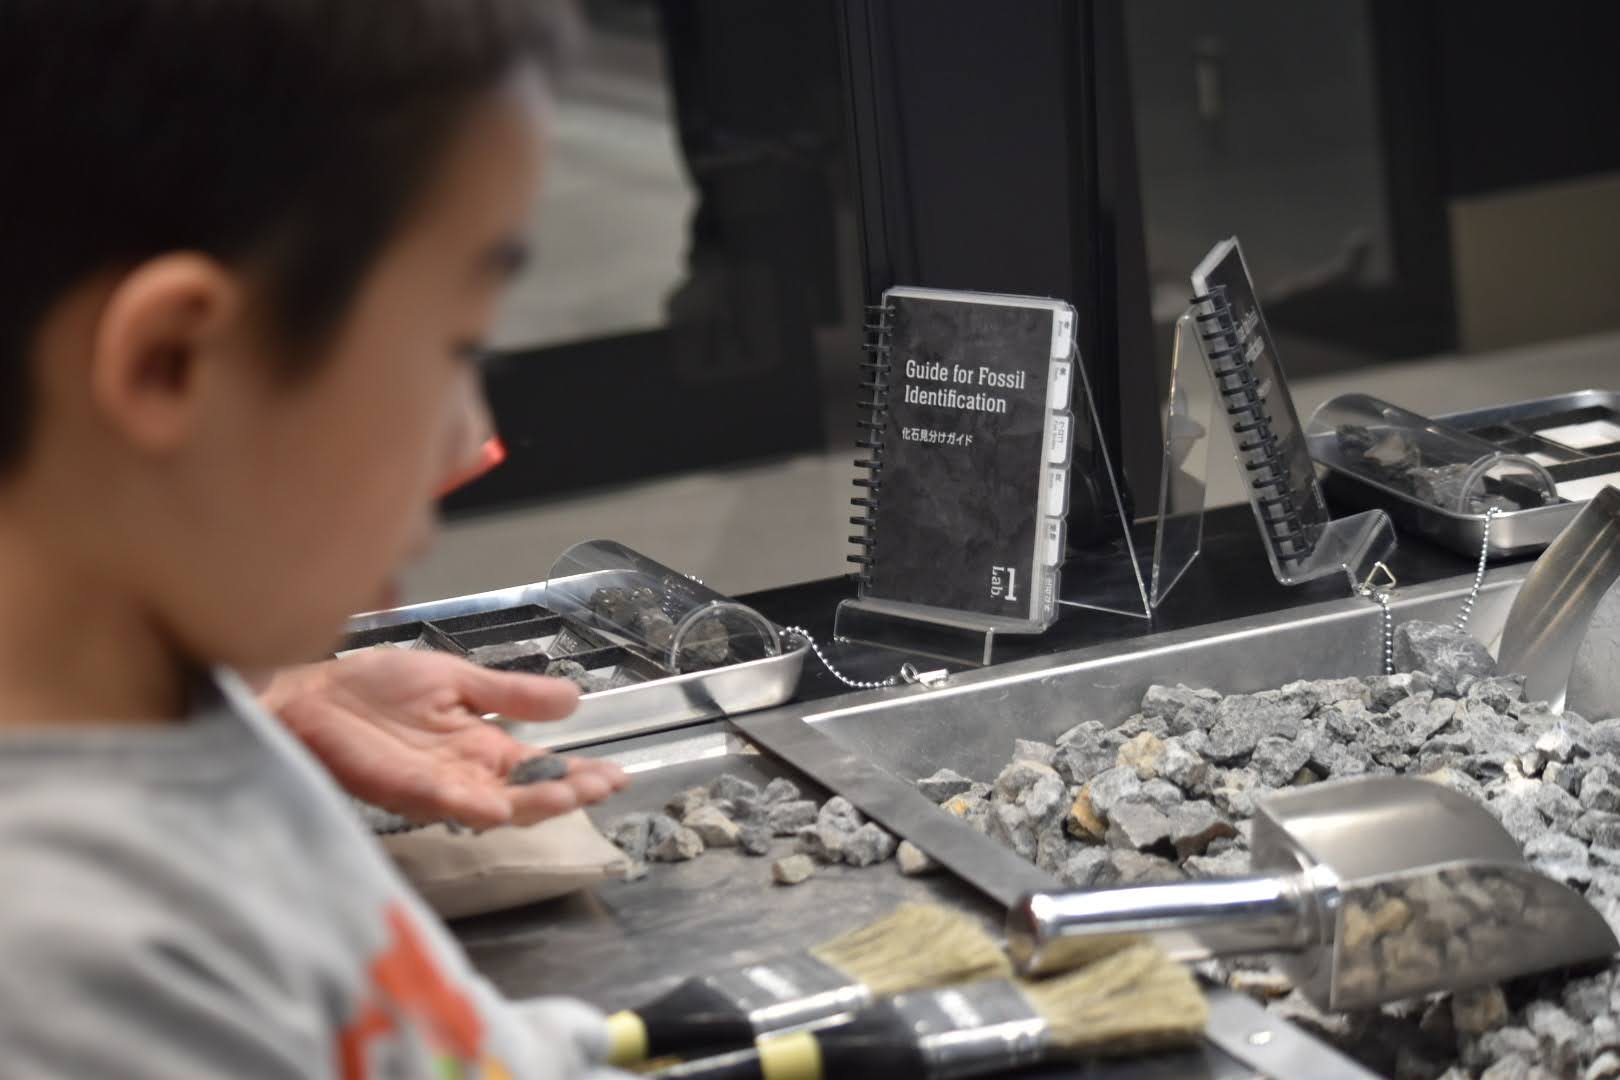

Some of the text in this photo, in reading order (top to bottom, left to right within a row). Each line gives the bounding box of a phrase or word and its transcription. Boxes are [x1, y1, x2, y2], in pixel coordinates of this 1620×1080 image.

[905, 359, 1025, 389] Guide for Fossil
[904, 384, 1007, 413] Identification
[902, 427, 973, 446] 化石見分けガイド
